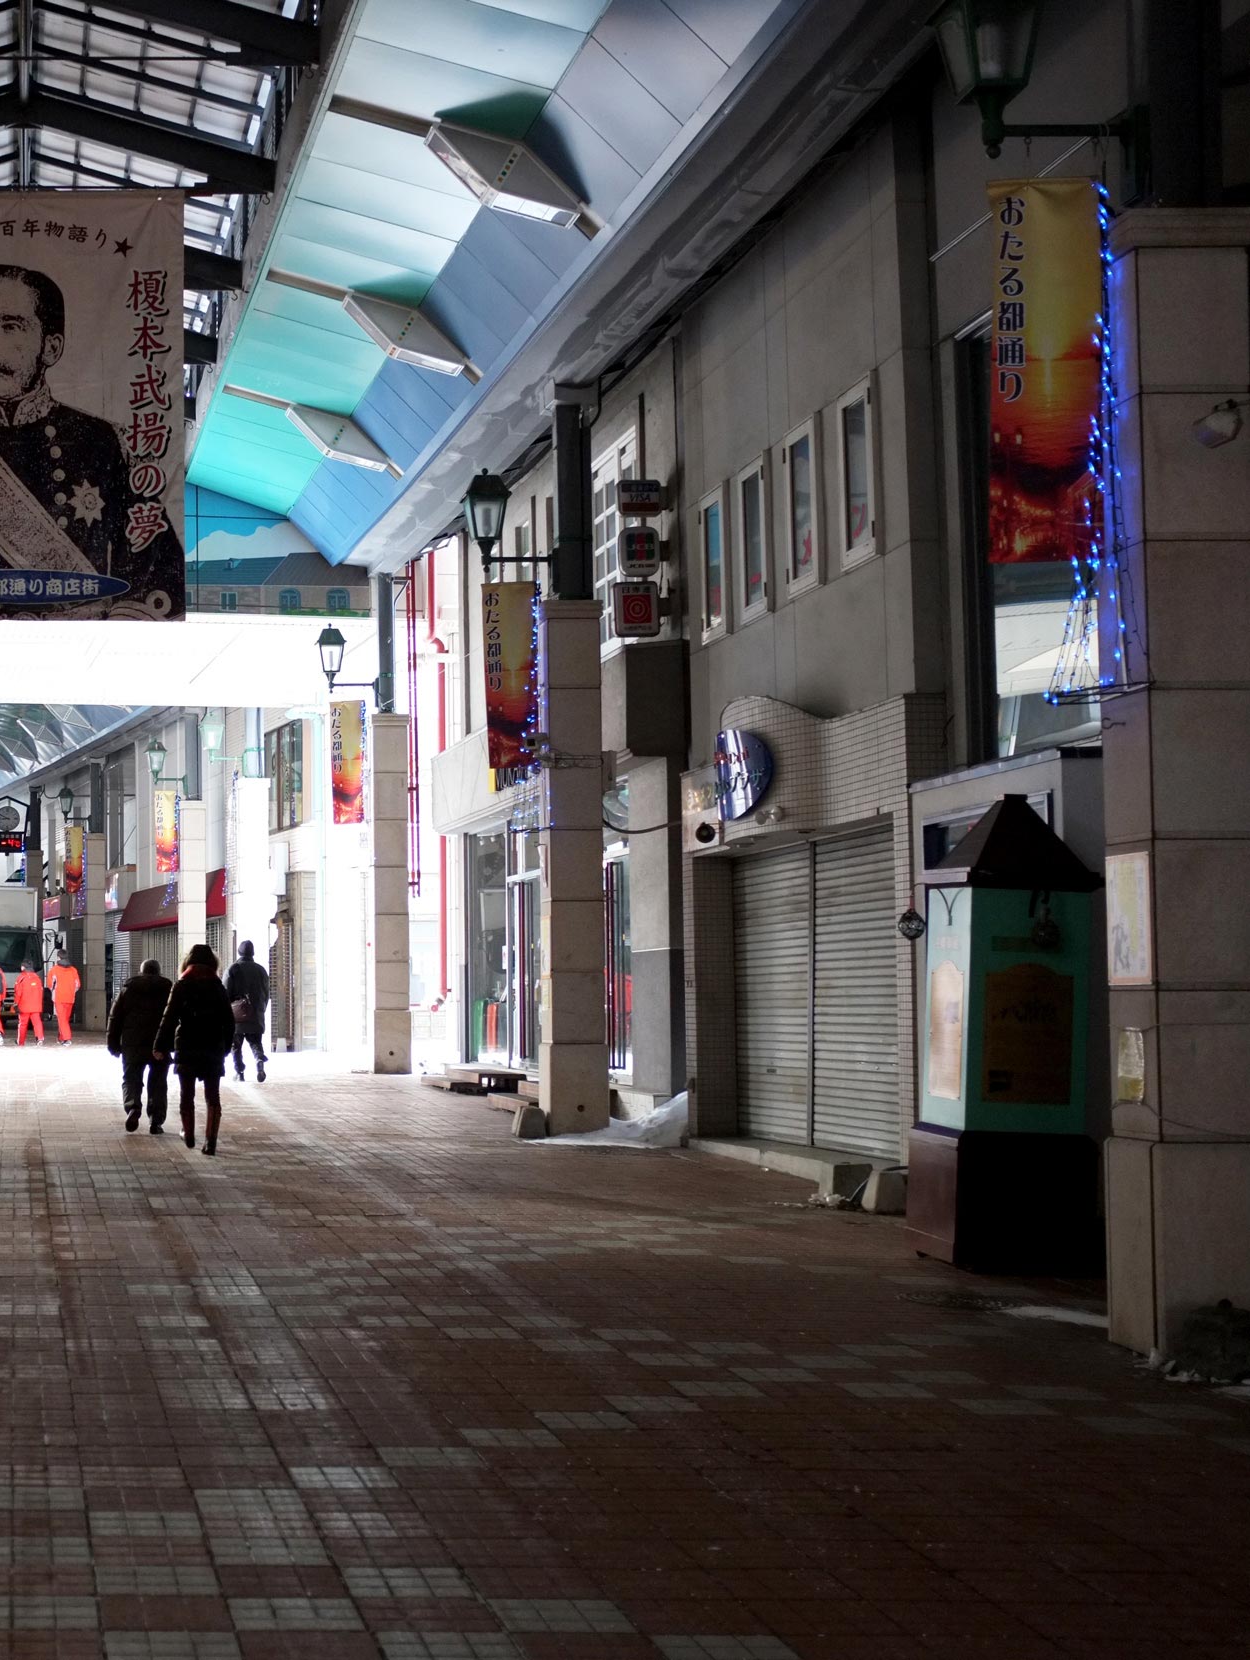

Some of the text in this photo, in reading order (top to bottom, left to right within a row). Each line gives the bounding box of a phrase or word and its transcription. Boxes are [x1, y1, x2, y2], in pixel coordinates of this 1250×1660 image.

[996, 196, 1026, 403] おたる都通り
[126, 269, 171, 553] 榎本武揚の夢
[629, 493, 651, 502] VISA
[485, 592, 502, 691] おたる都通り
[331, 707, 343, 773] おたる都通り
